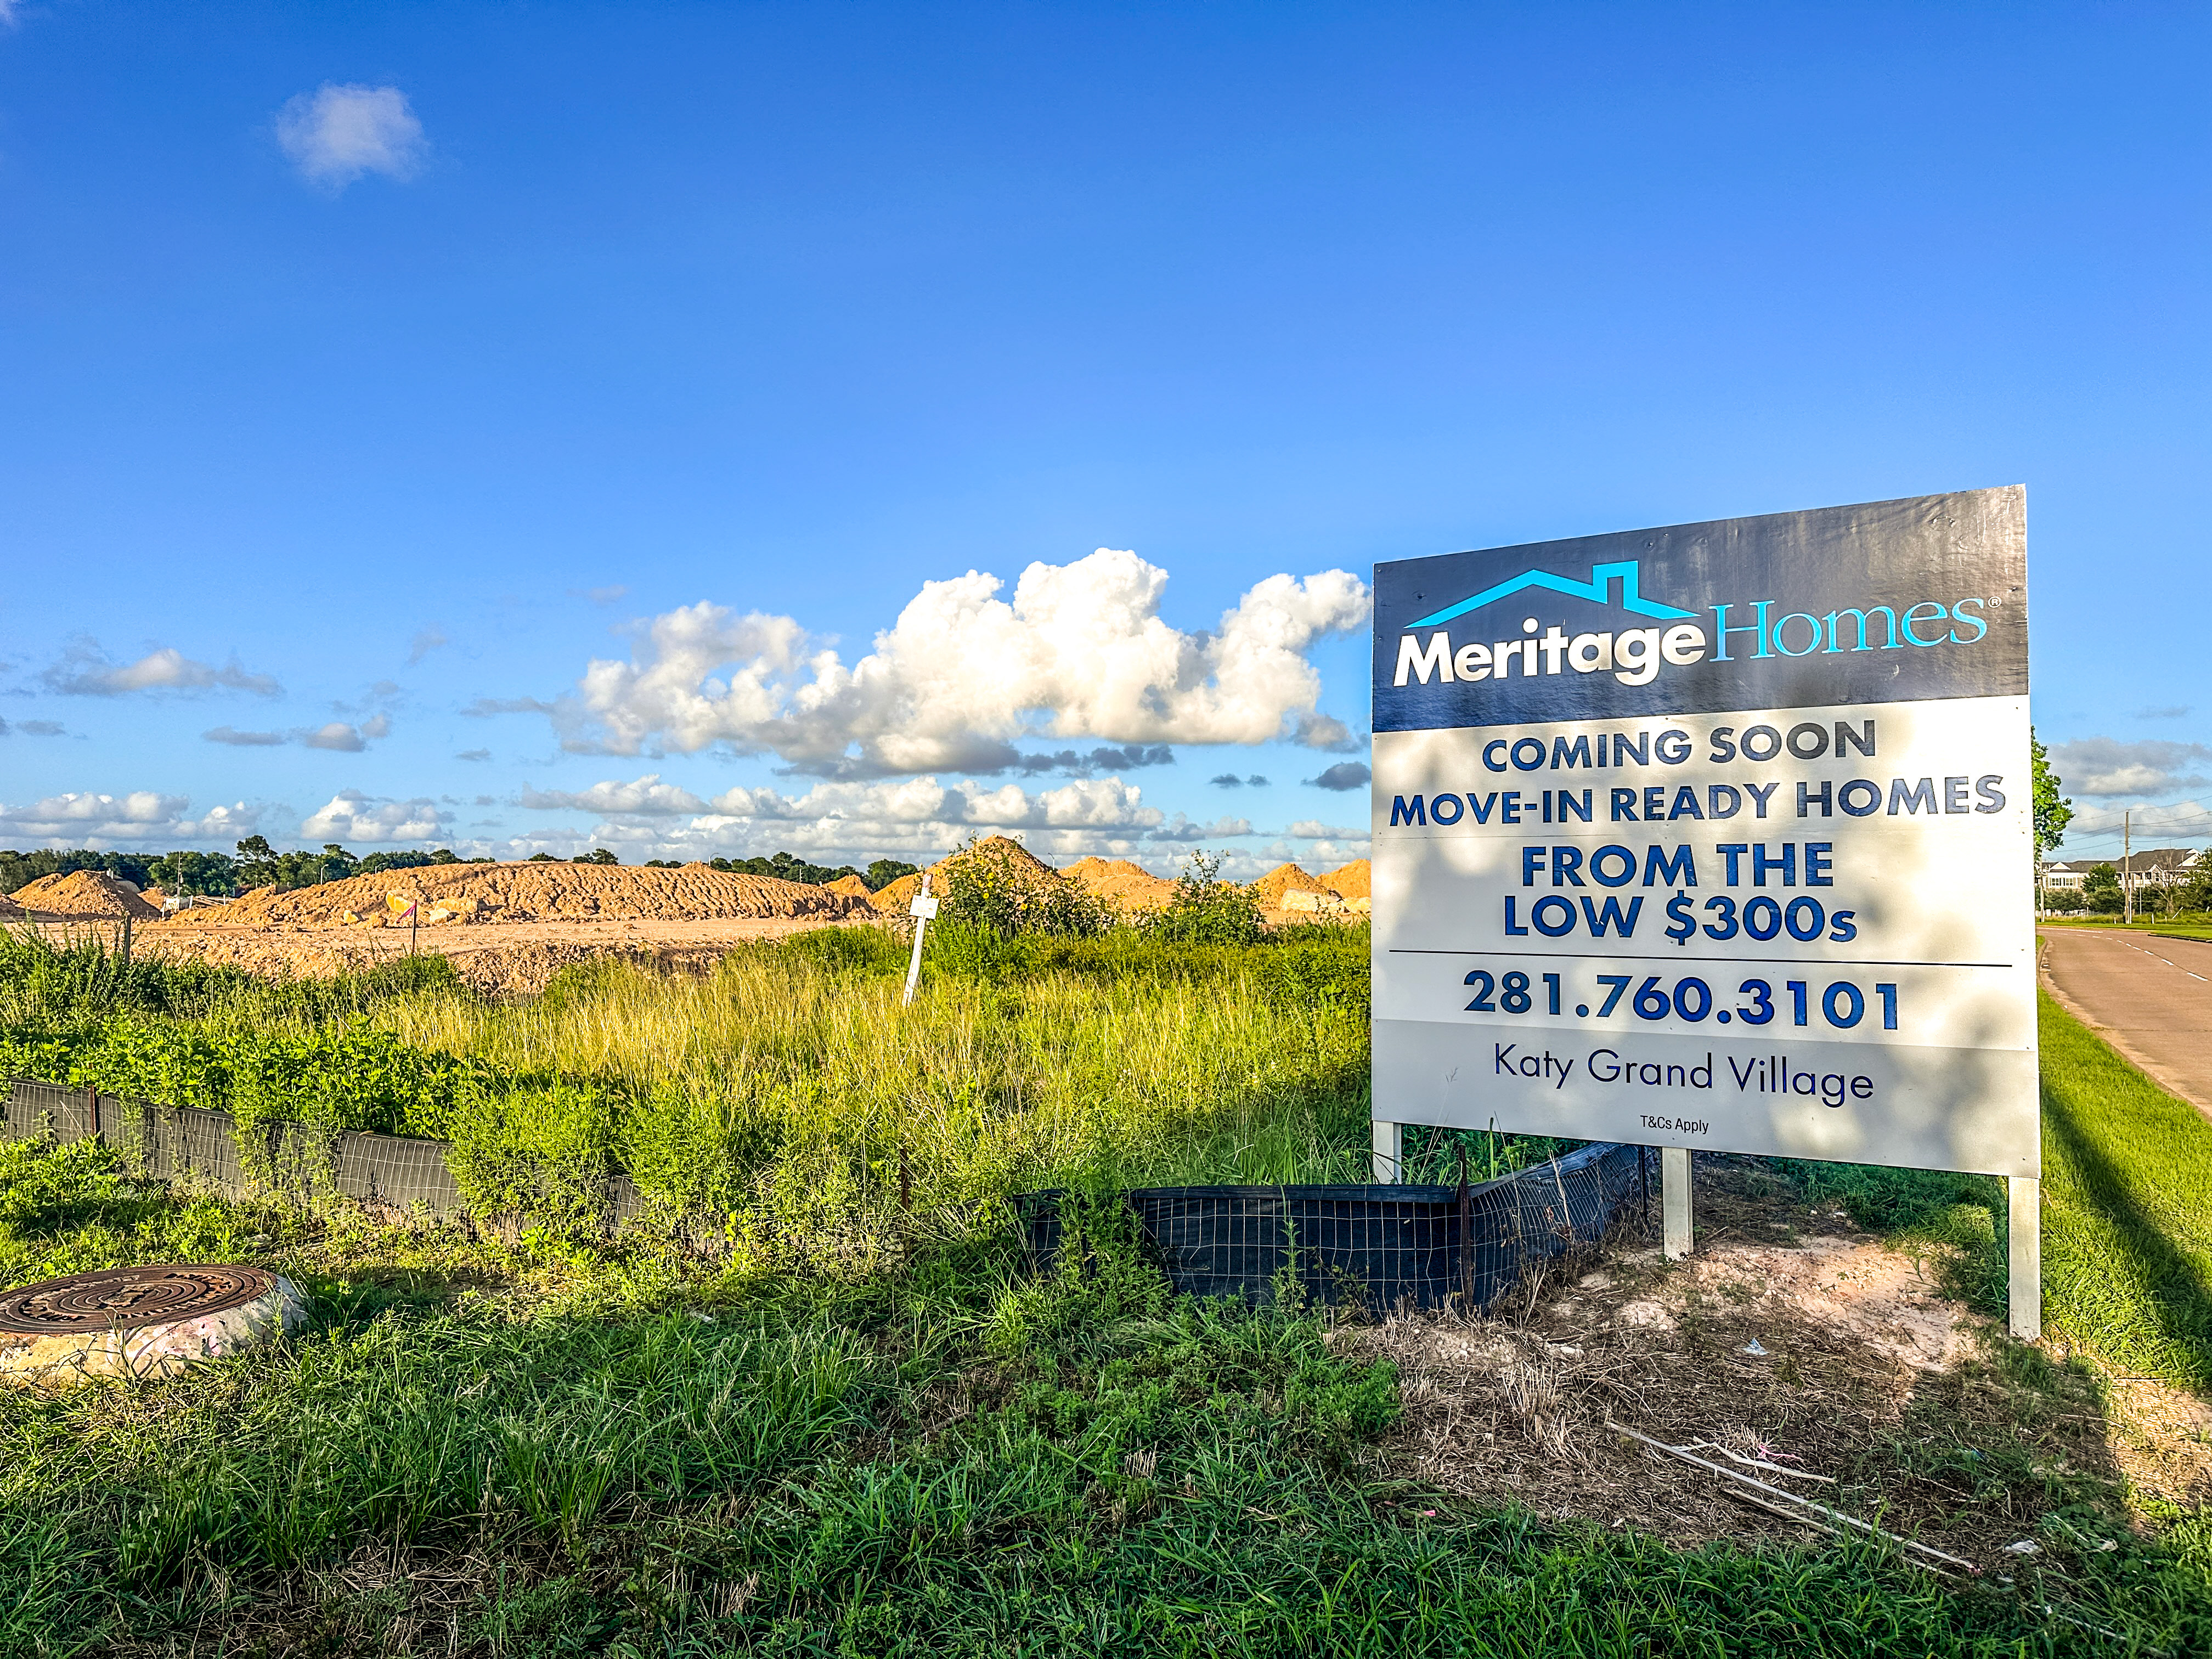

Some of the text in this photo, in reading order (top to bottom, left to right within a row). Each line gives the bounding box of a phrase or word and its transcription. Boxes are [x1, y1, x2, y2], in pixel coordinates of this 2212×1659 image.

[1392, 617, 1707, 686] Meritage
[1482, 720, 1875, 772] COMING SOON
[1389, 775, 2006, 827] MOVE-IN READY HOMES
[1522, 842, 1834, 887] FROM THE
[1504, 890, 1858, 946] LOW $300s
[1464, 970, 1898, 1030] 281.760.3101
[1495, 1042, 1874, 1108] Katy Grand Village
[1640, 1115, 1709, 1136] T&Cs Apply
